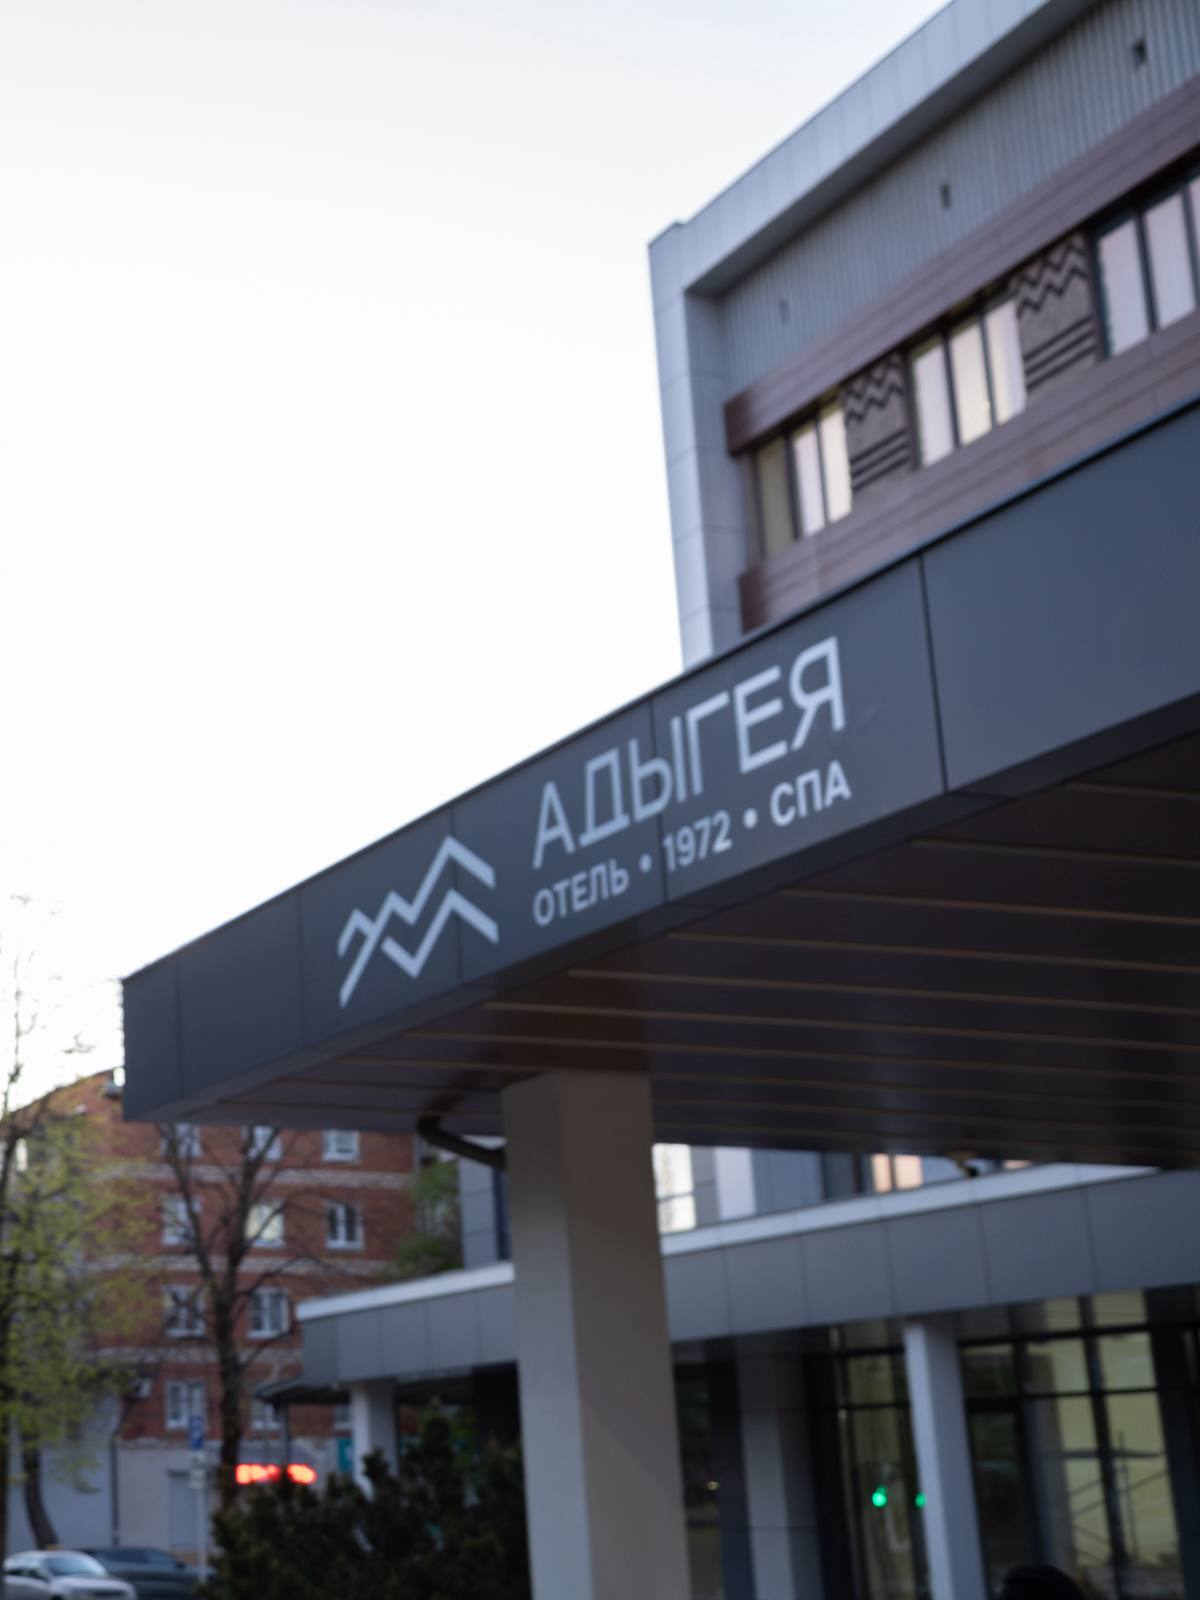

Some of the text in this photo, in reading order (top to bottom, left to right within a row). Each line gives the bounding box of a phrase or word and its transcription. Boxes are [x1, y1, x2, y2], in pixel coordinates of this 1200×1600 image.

[533, 637, 846, 869] АДЫГЕЯ
[533, 760, 852, 926] ОТЕЛЬ 1972 СПА
